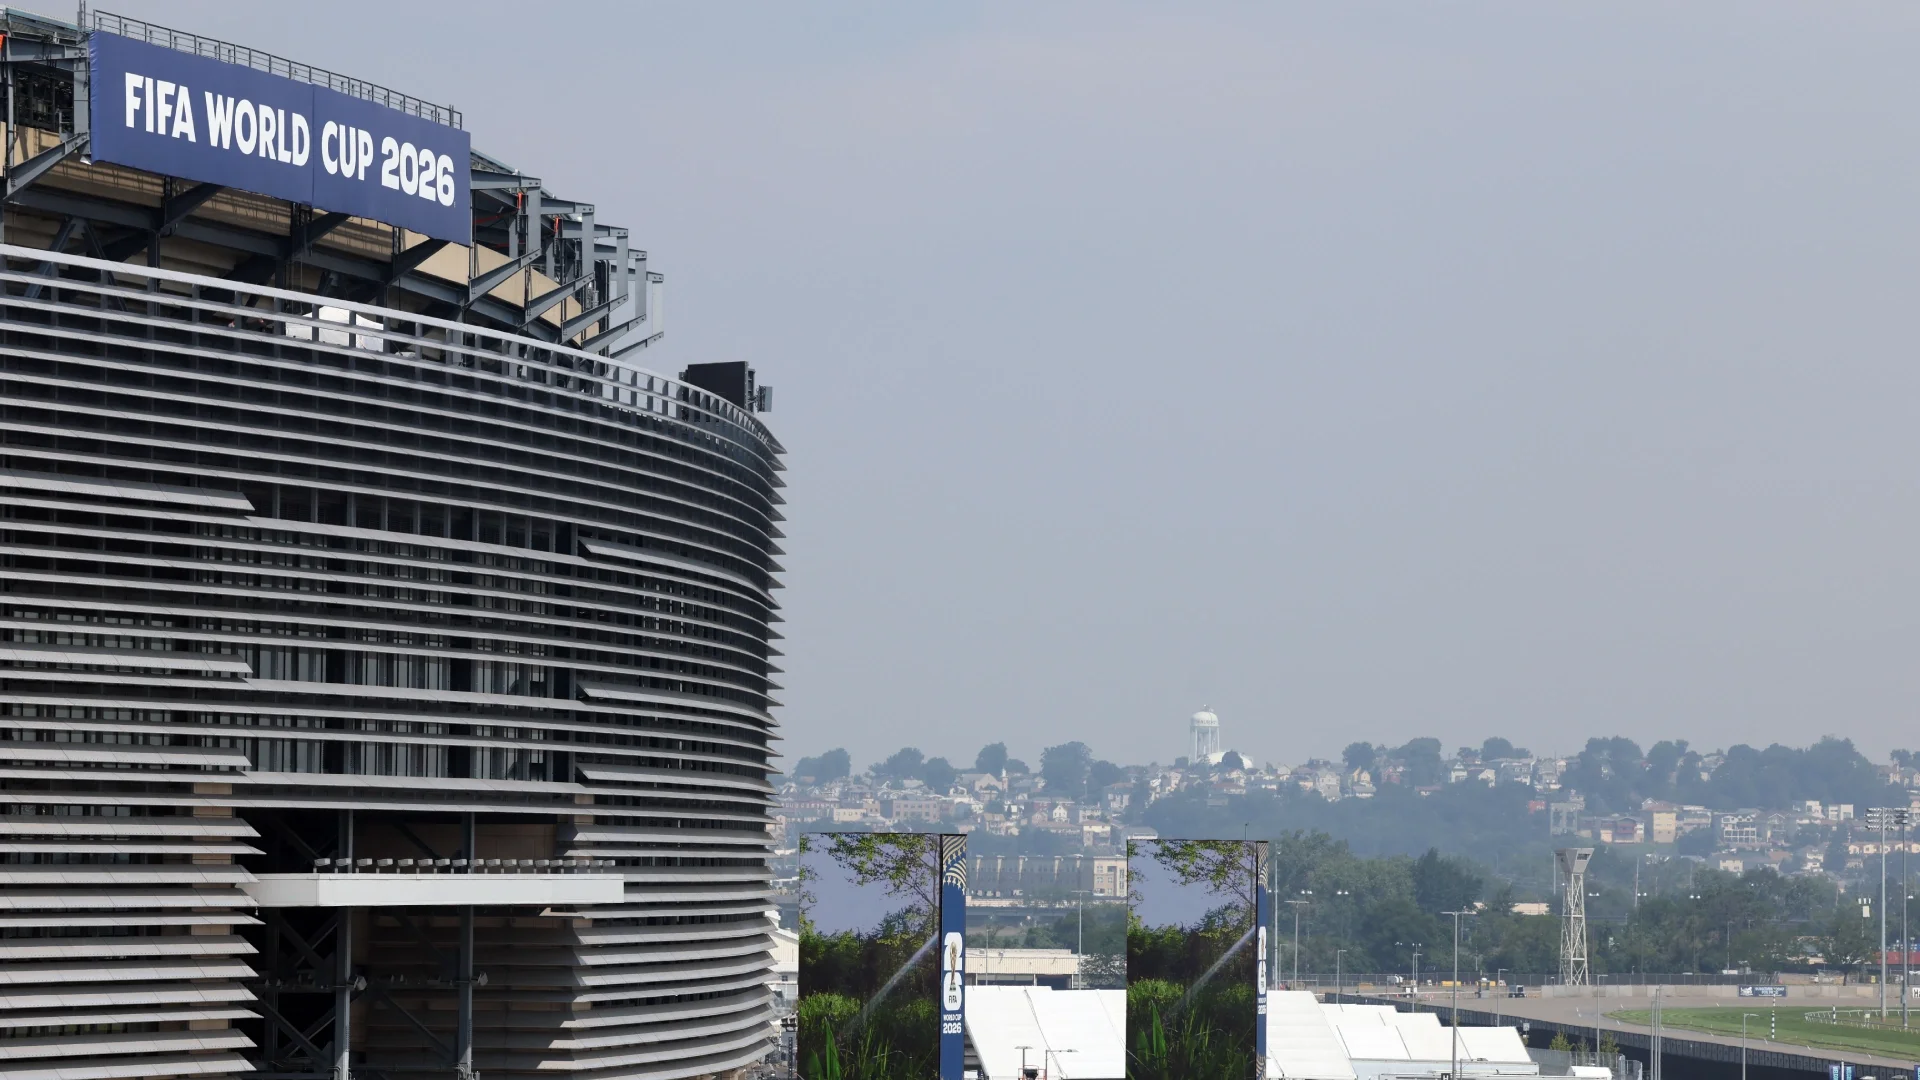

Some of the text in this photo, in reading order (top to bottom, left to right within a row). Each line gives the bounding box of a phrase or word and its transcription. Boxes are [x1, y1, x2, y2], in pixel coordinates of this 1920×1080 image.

[125, 72, 455, 207] FIFA WORLD CUP 2026
[944, 932, 962, 970] 2
[944, 972, 962, 1010] 6
[948, 995, 957, 1004] FIFA
[943, 1022, 962, 1034] 2026
